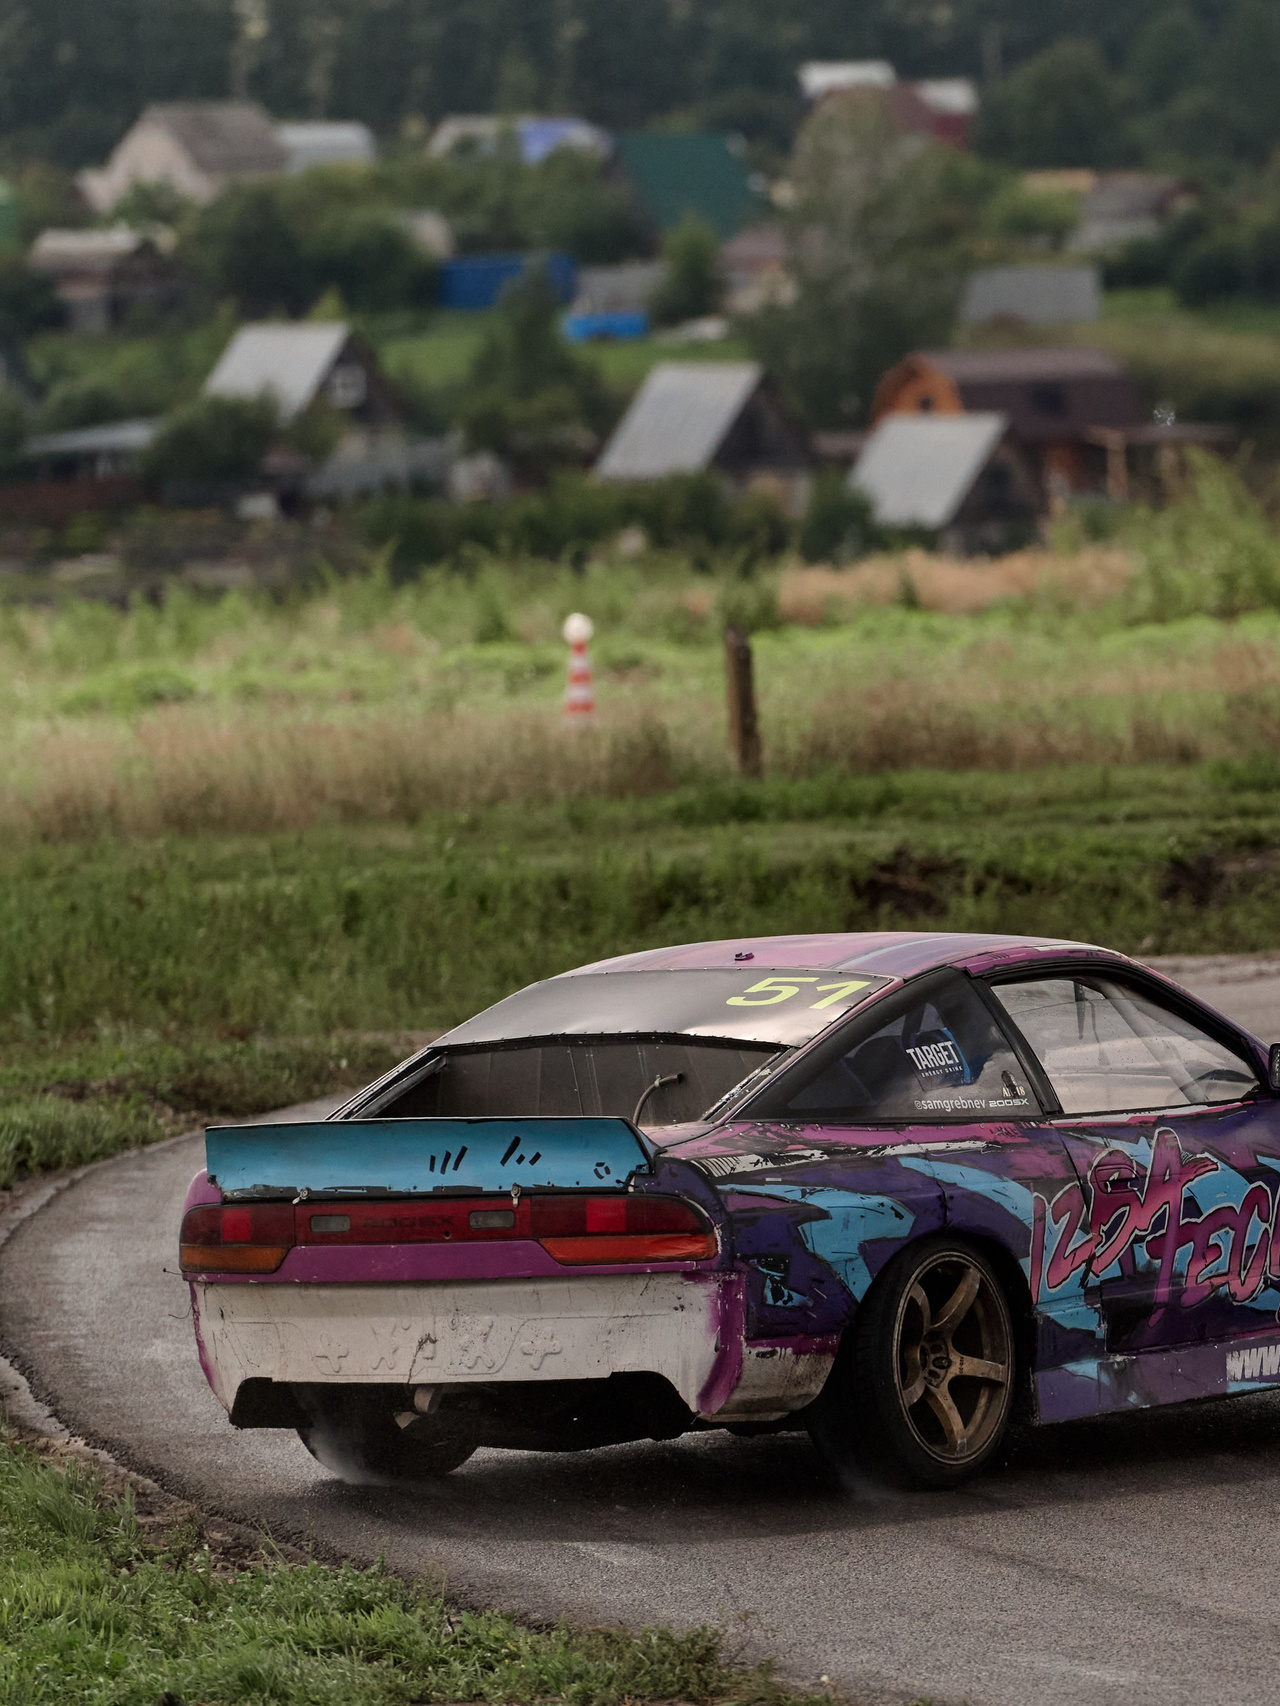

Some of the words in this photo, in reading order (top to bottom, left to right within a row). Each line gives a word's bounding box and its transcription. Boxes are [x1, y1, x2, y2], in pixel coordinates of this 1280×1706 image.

[725, 977, 872, 1009] 51
[905, 1041, 959, 1070] TARGET
[921, 1069, 943, 1078] ENERGY
[945, 1065, 963, 1073] DRINK
[988, 1098, 1029, 1108] 200SX
